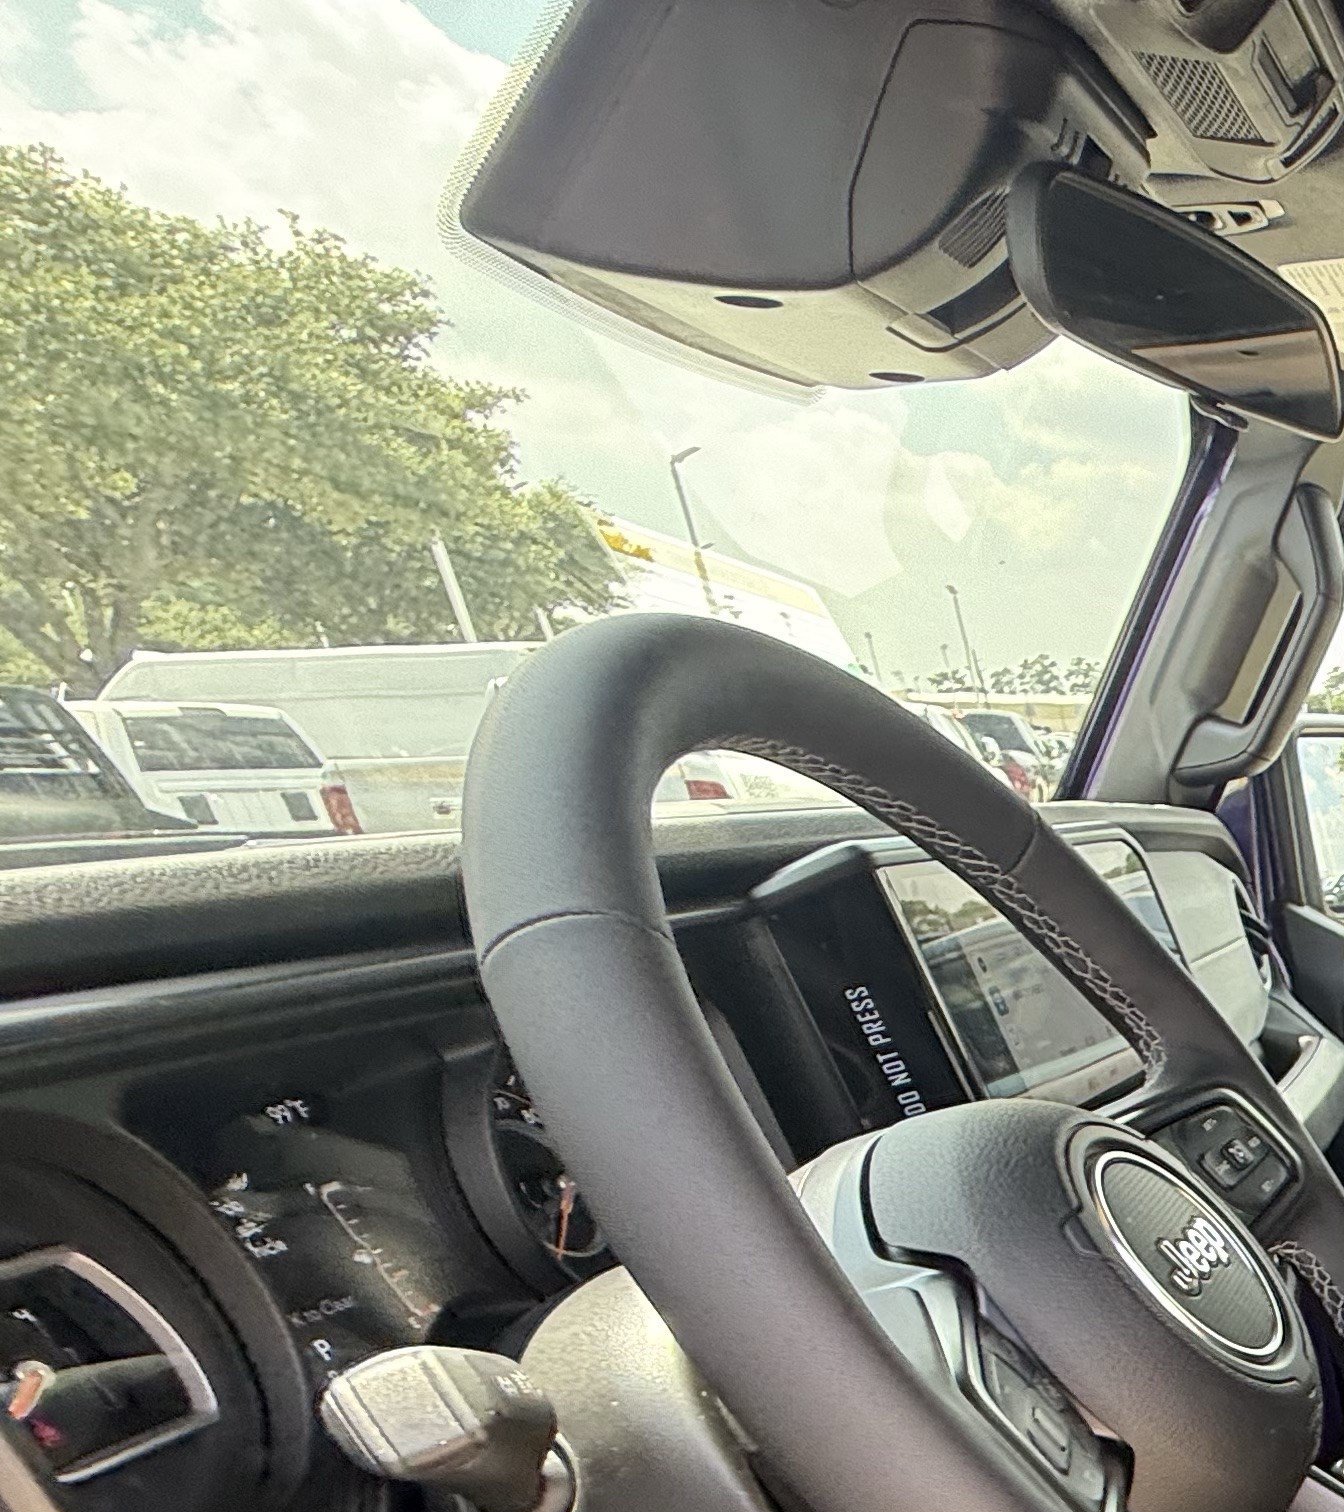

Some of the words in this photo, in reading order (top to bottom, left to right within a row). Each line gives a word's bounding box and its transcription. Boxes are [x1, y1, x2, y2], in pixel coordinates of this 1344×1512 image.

[844, 986, 892, 1046] PRESS
[876, 1051, 912, 1086] NOT
[897, 1090, 926, 1116] DO
[1158, 1215, 1231, 1294] Jeep
[312, 1339, 332, 1361] P
